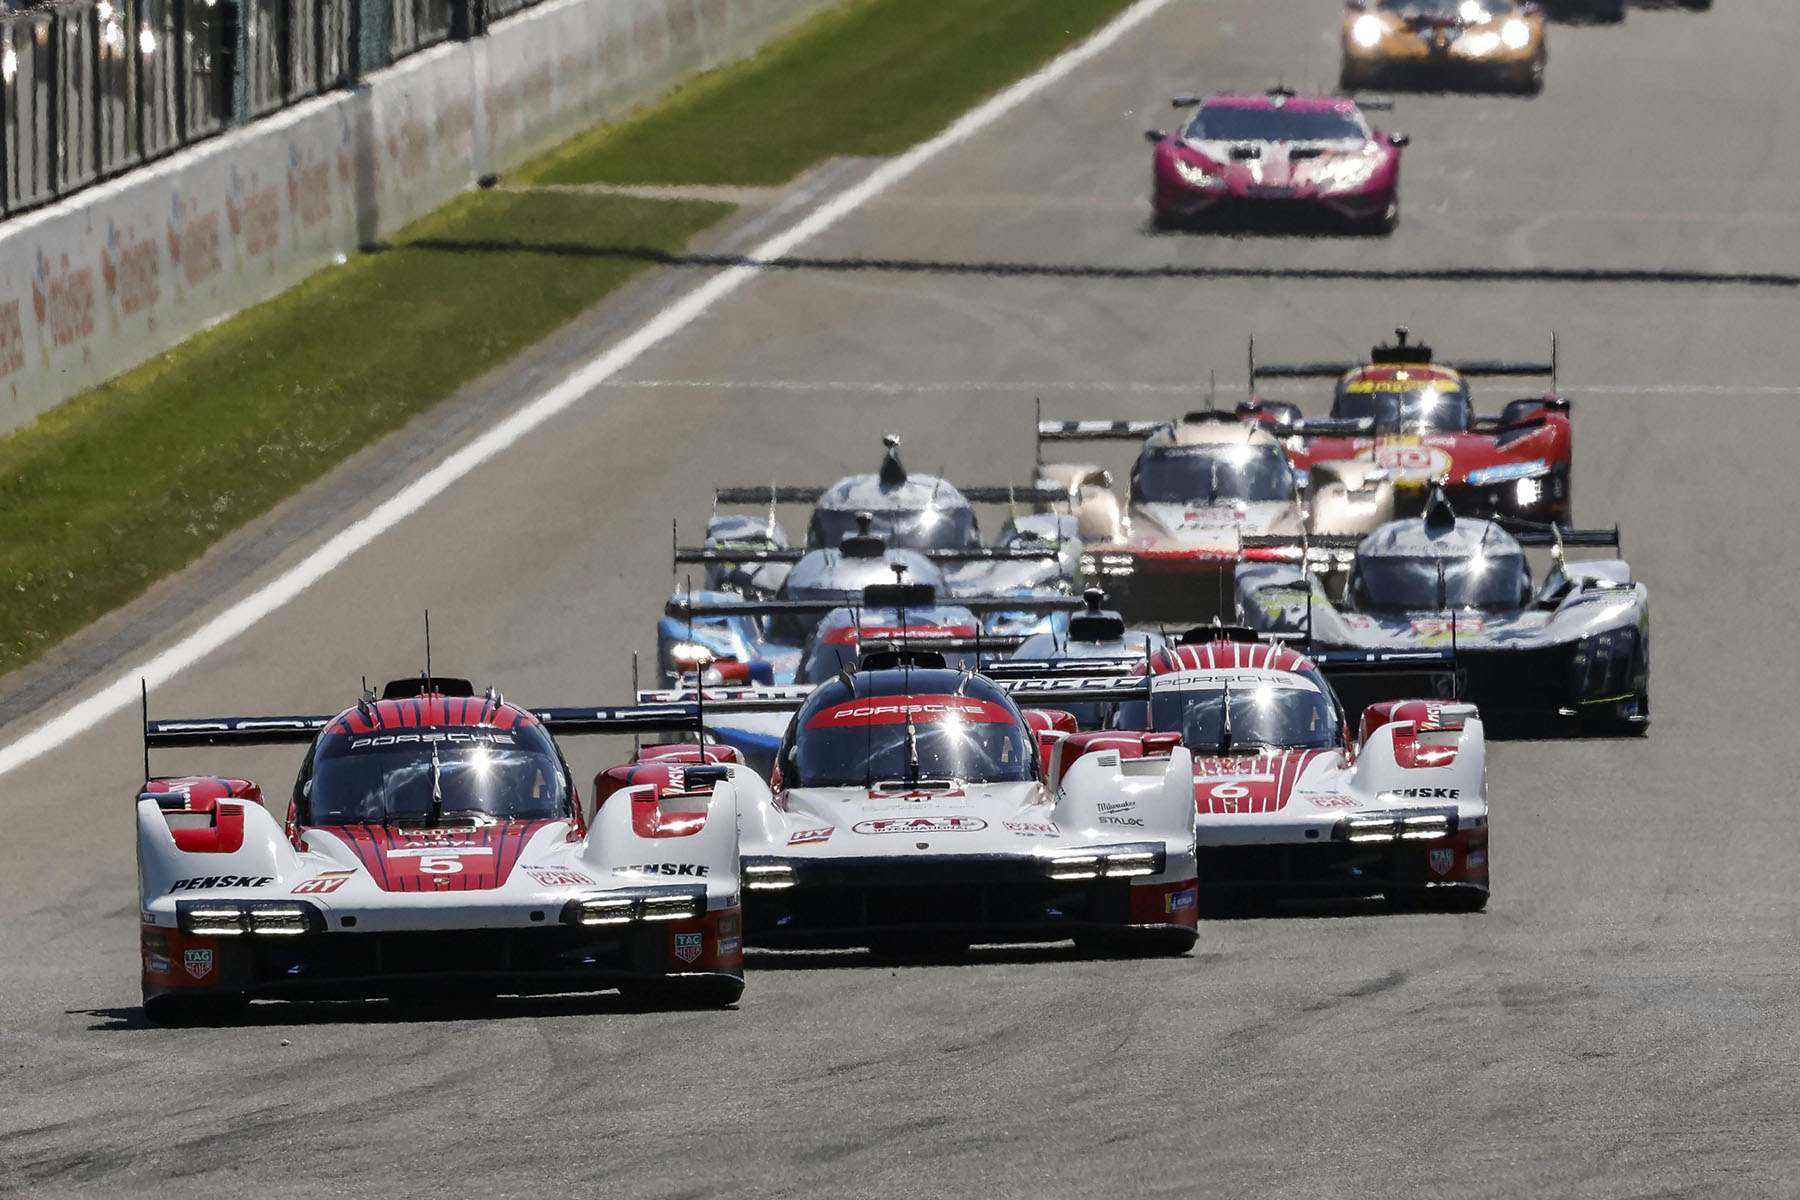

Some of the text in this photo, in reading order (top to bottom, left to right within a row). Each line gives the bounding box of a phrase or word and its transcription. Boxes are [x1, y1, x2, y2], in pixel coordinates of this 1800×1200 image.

[1155, 675, 1294, 688] PORSCHE
[834, 704, 984, 719] PORSCHE
[351, 733, 516, 749] PORSCHE
[1210, 782, 1249, 799] 6
[1099, 816, 1145, 826] STALOC
[419, 855, 464, 874] 5
[169, 875, 274, 894] PENSKE
[678, 935, 700, 945] TAG
[186, 951, 210, 961] TAG
